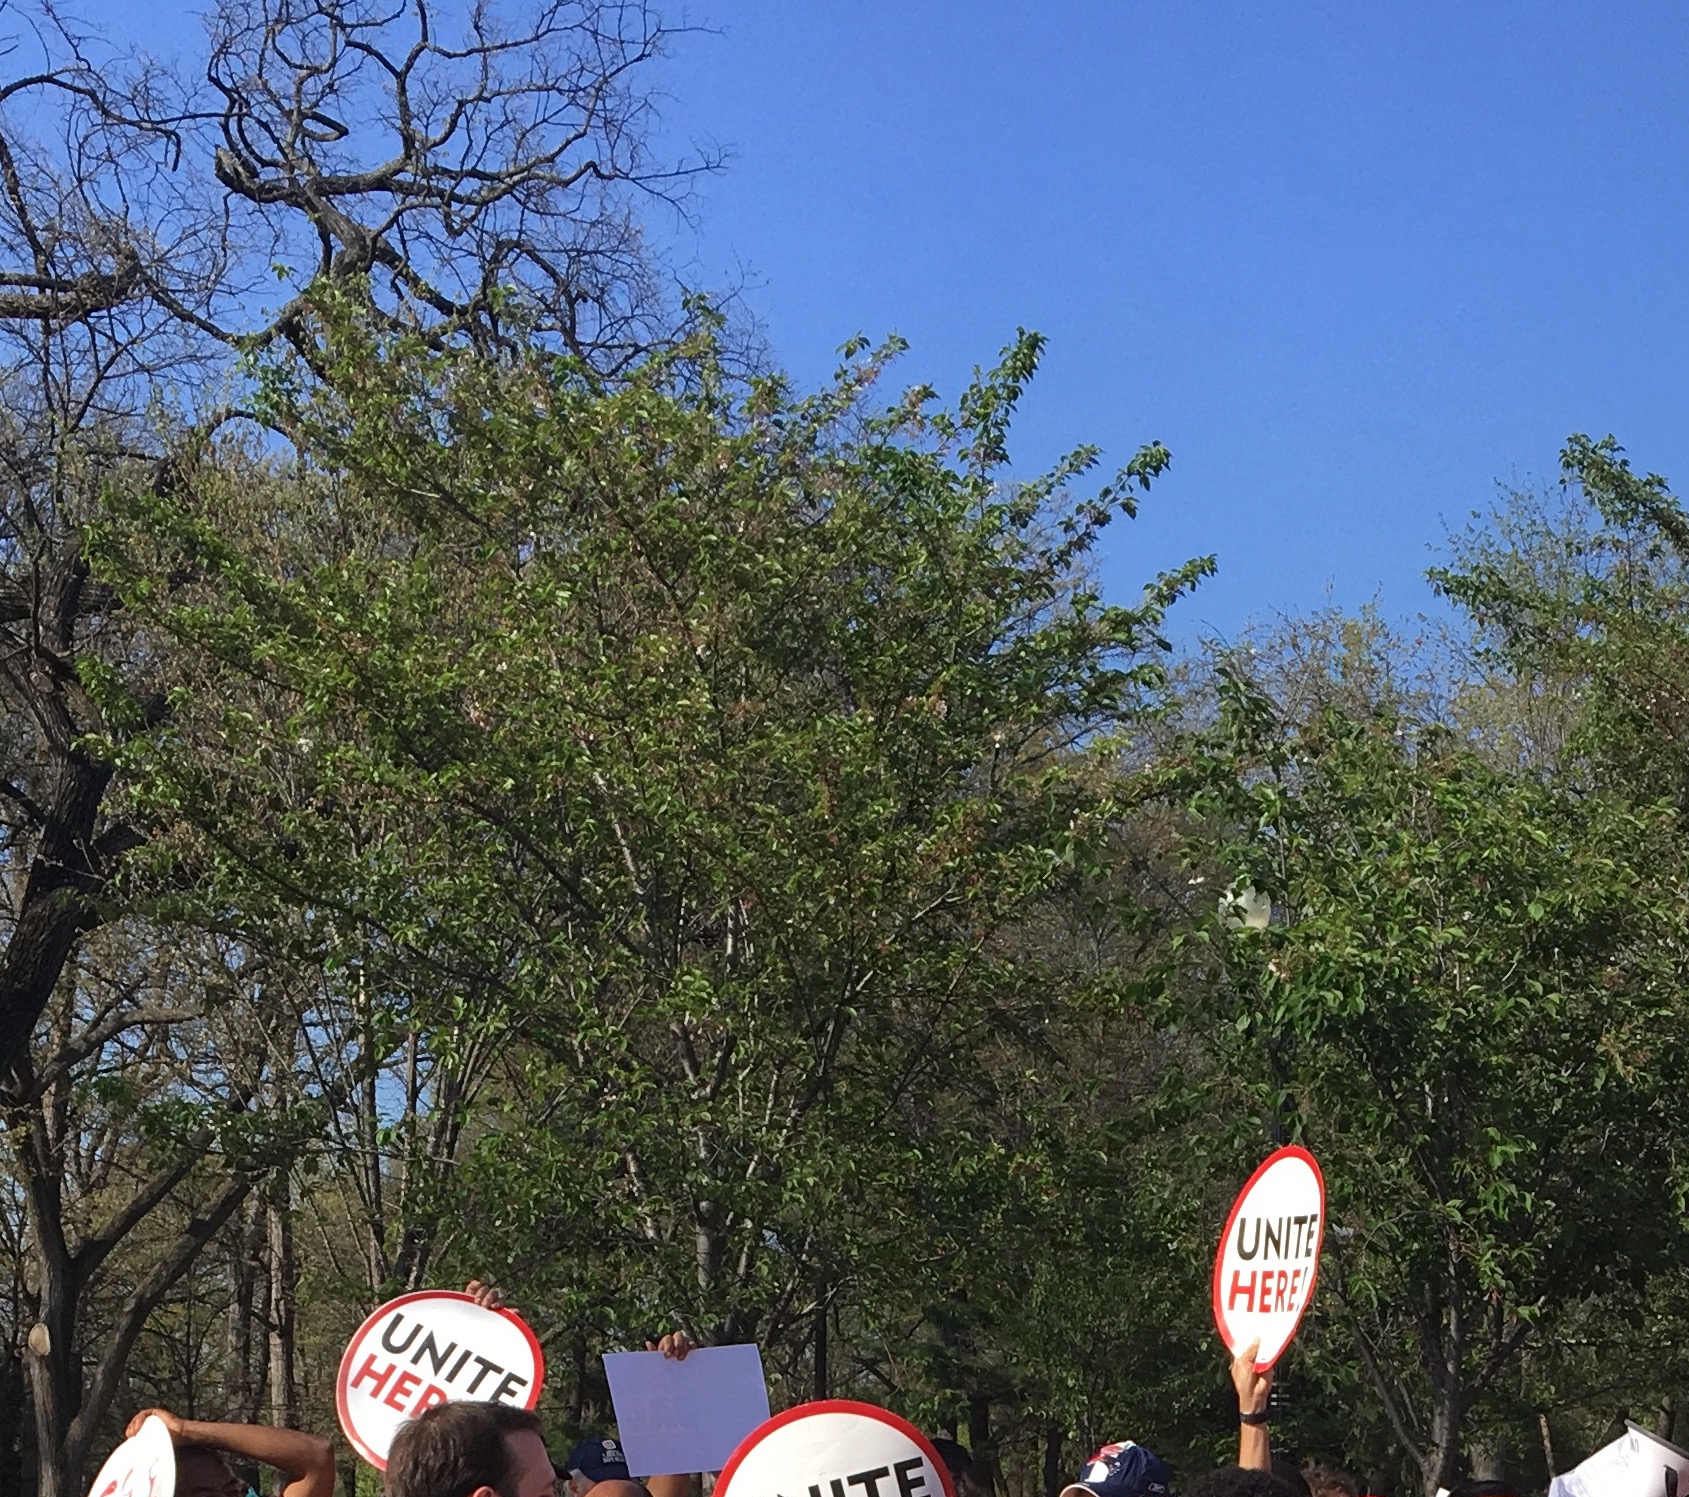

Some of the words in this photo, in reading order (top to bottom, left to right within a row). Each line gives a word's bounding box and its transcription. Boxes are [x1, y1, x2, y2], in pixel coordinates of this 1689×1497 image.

[1237, 1214, 1319, 1260] UNITE
[1227, 1266, 1309, 1314] HERE!
[381, 1312, 529, 1402] UNITE
[350, 1353, 448, 1418] HER
